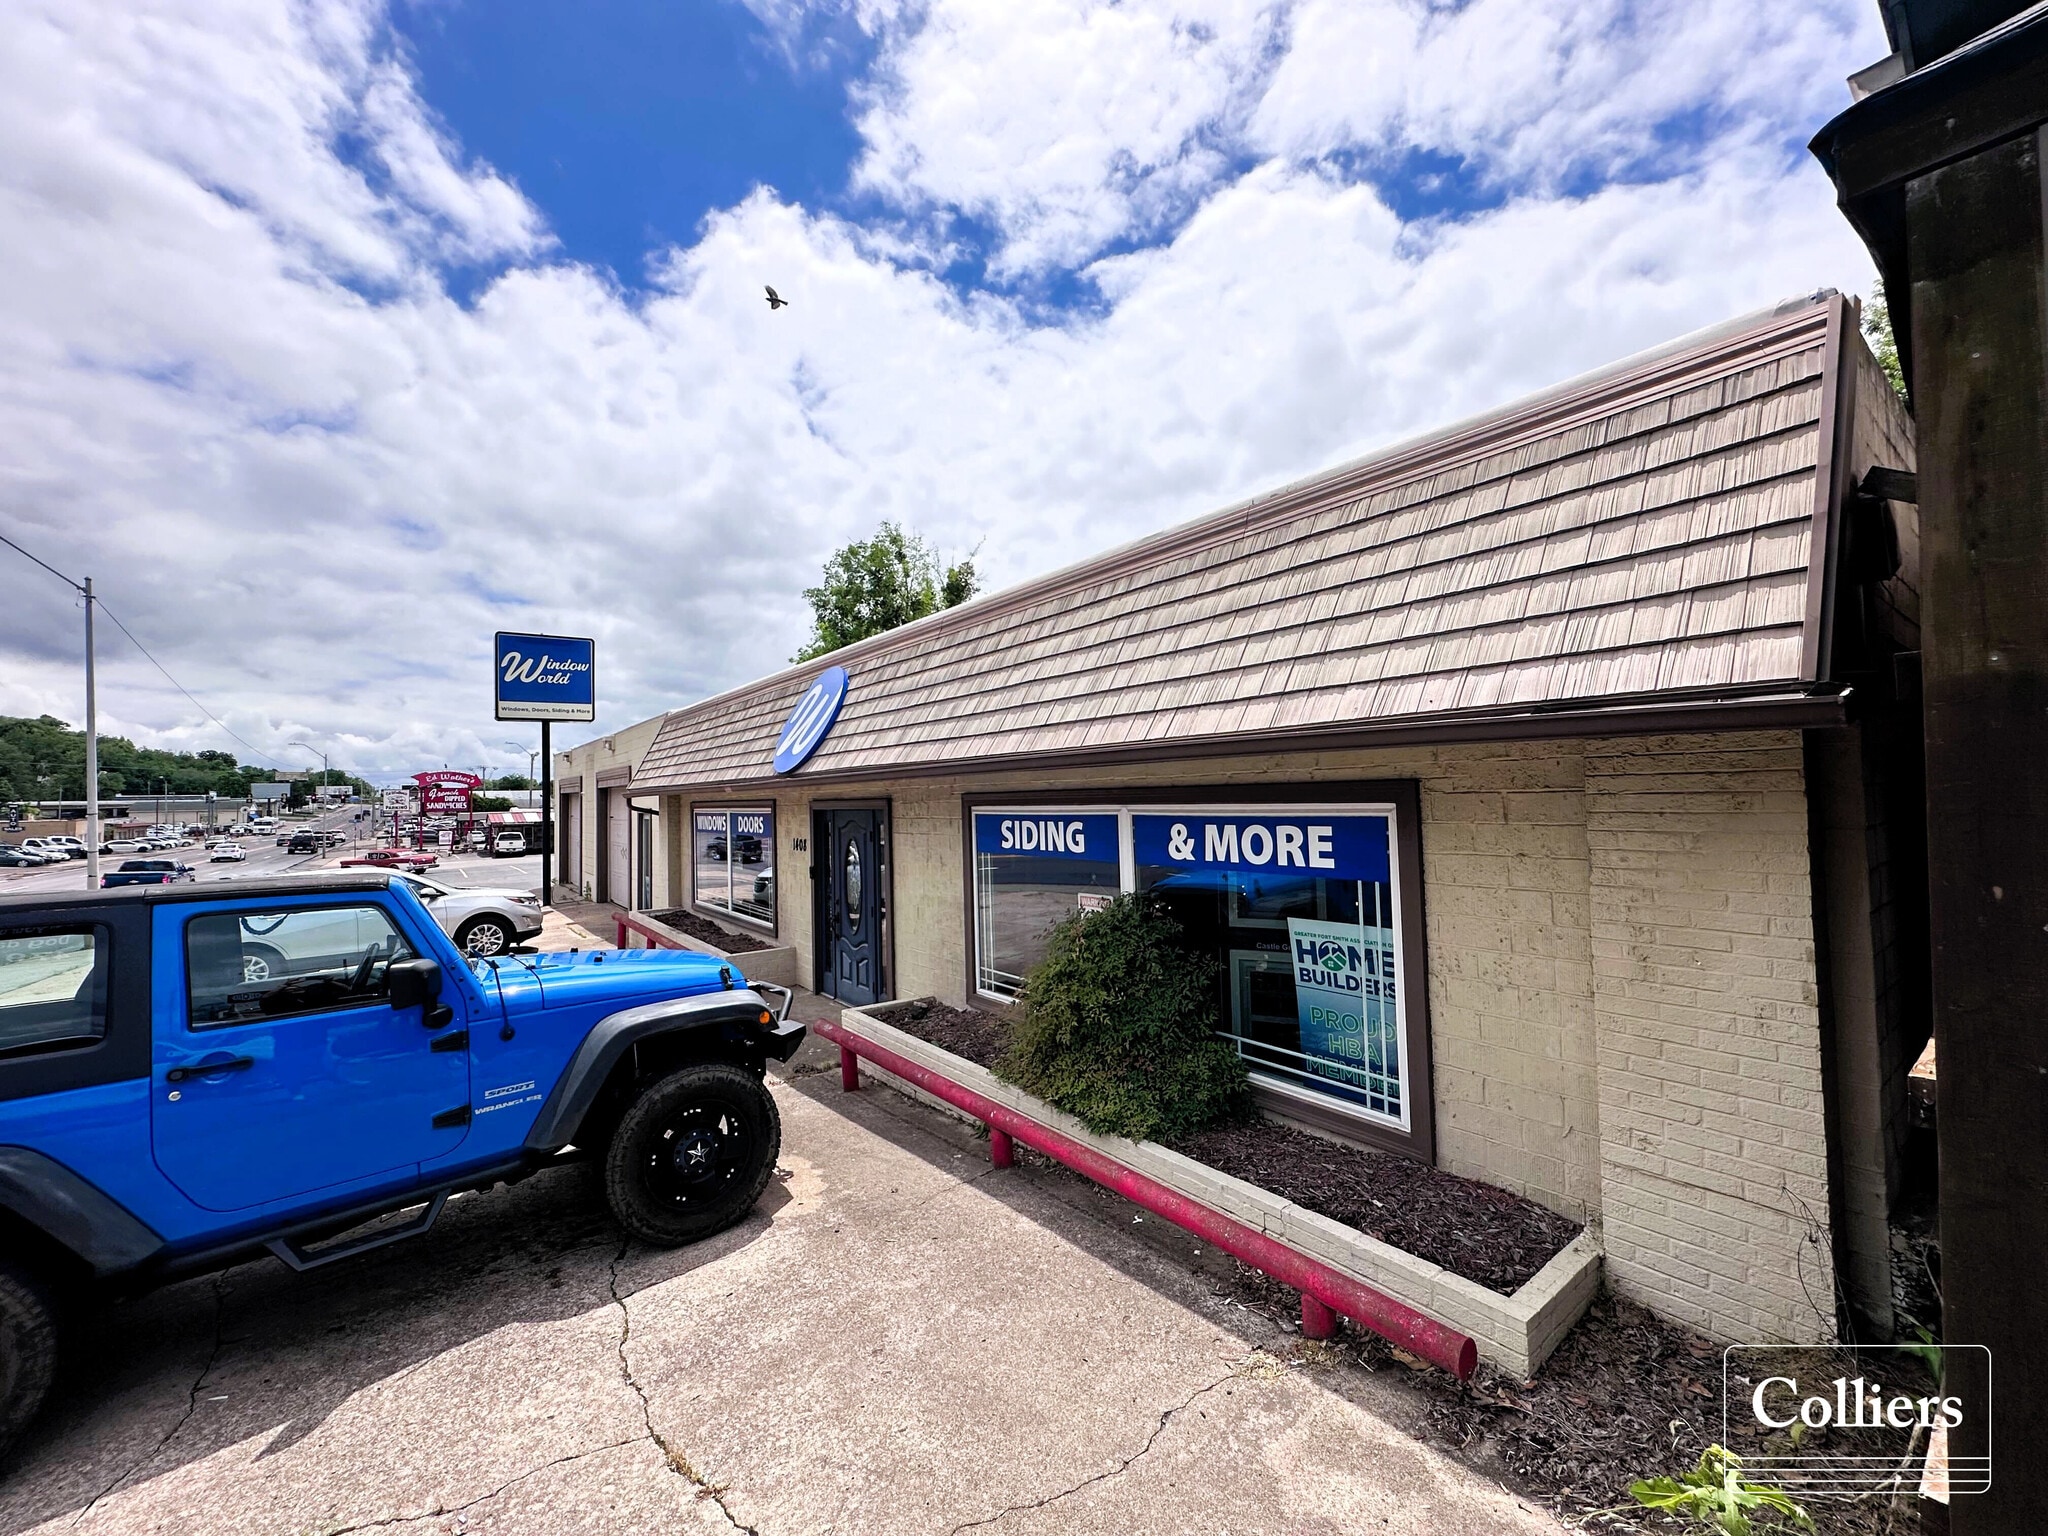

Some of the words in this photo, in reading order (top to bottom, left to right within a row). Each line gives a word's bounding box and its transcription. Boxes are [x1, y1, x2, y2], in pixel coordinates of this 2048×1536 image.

[501, 651, 590, 683] Window
[426, 801, 468, 809] SANDWICHES
[428, 788, 459, 800] French
[696, 815, 727, 831] WINDOWS
[737, 816, 764, 834] DOORS
[1001, 820, 1086, 854] SIDING
[1168, 822, 1196, 862] &
[1204, 824, 1336, 869] MORE
[1081, 896, 1111, 908] WARN
[1293, 930, 1317, 938] GREATER
[1349, 937, 1387, 948] ASSCIATIN
[1295, 939, 1396, 979] HOME
[1299, 967, 1396, 999] BUILDERS
[1310, 1005, 1397, 1043] PROUD
[1328, 1033, 1382, 1066] HBA
[486, 1081, 534, 1098] SPORT
[474, 1093, 543, 1115] WRANGLER
